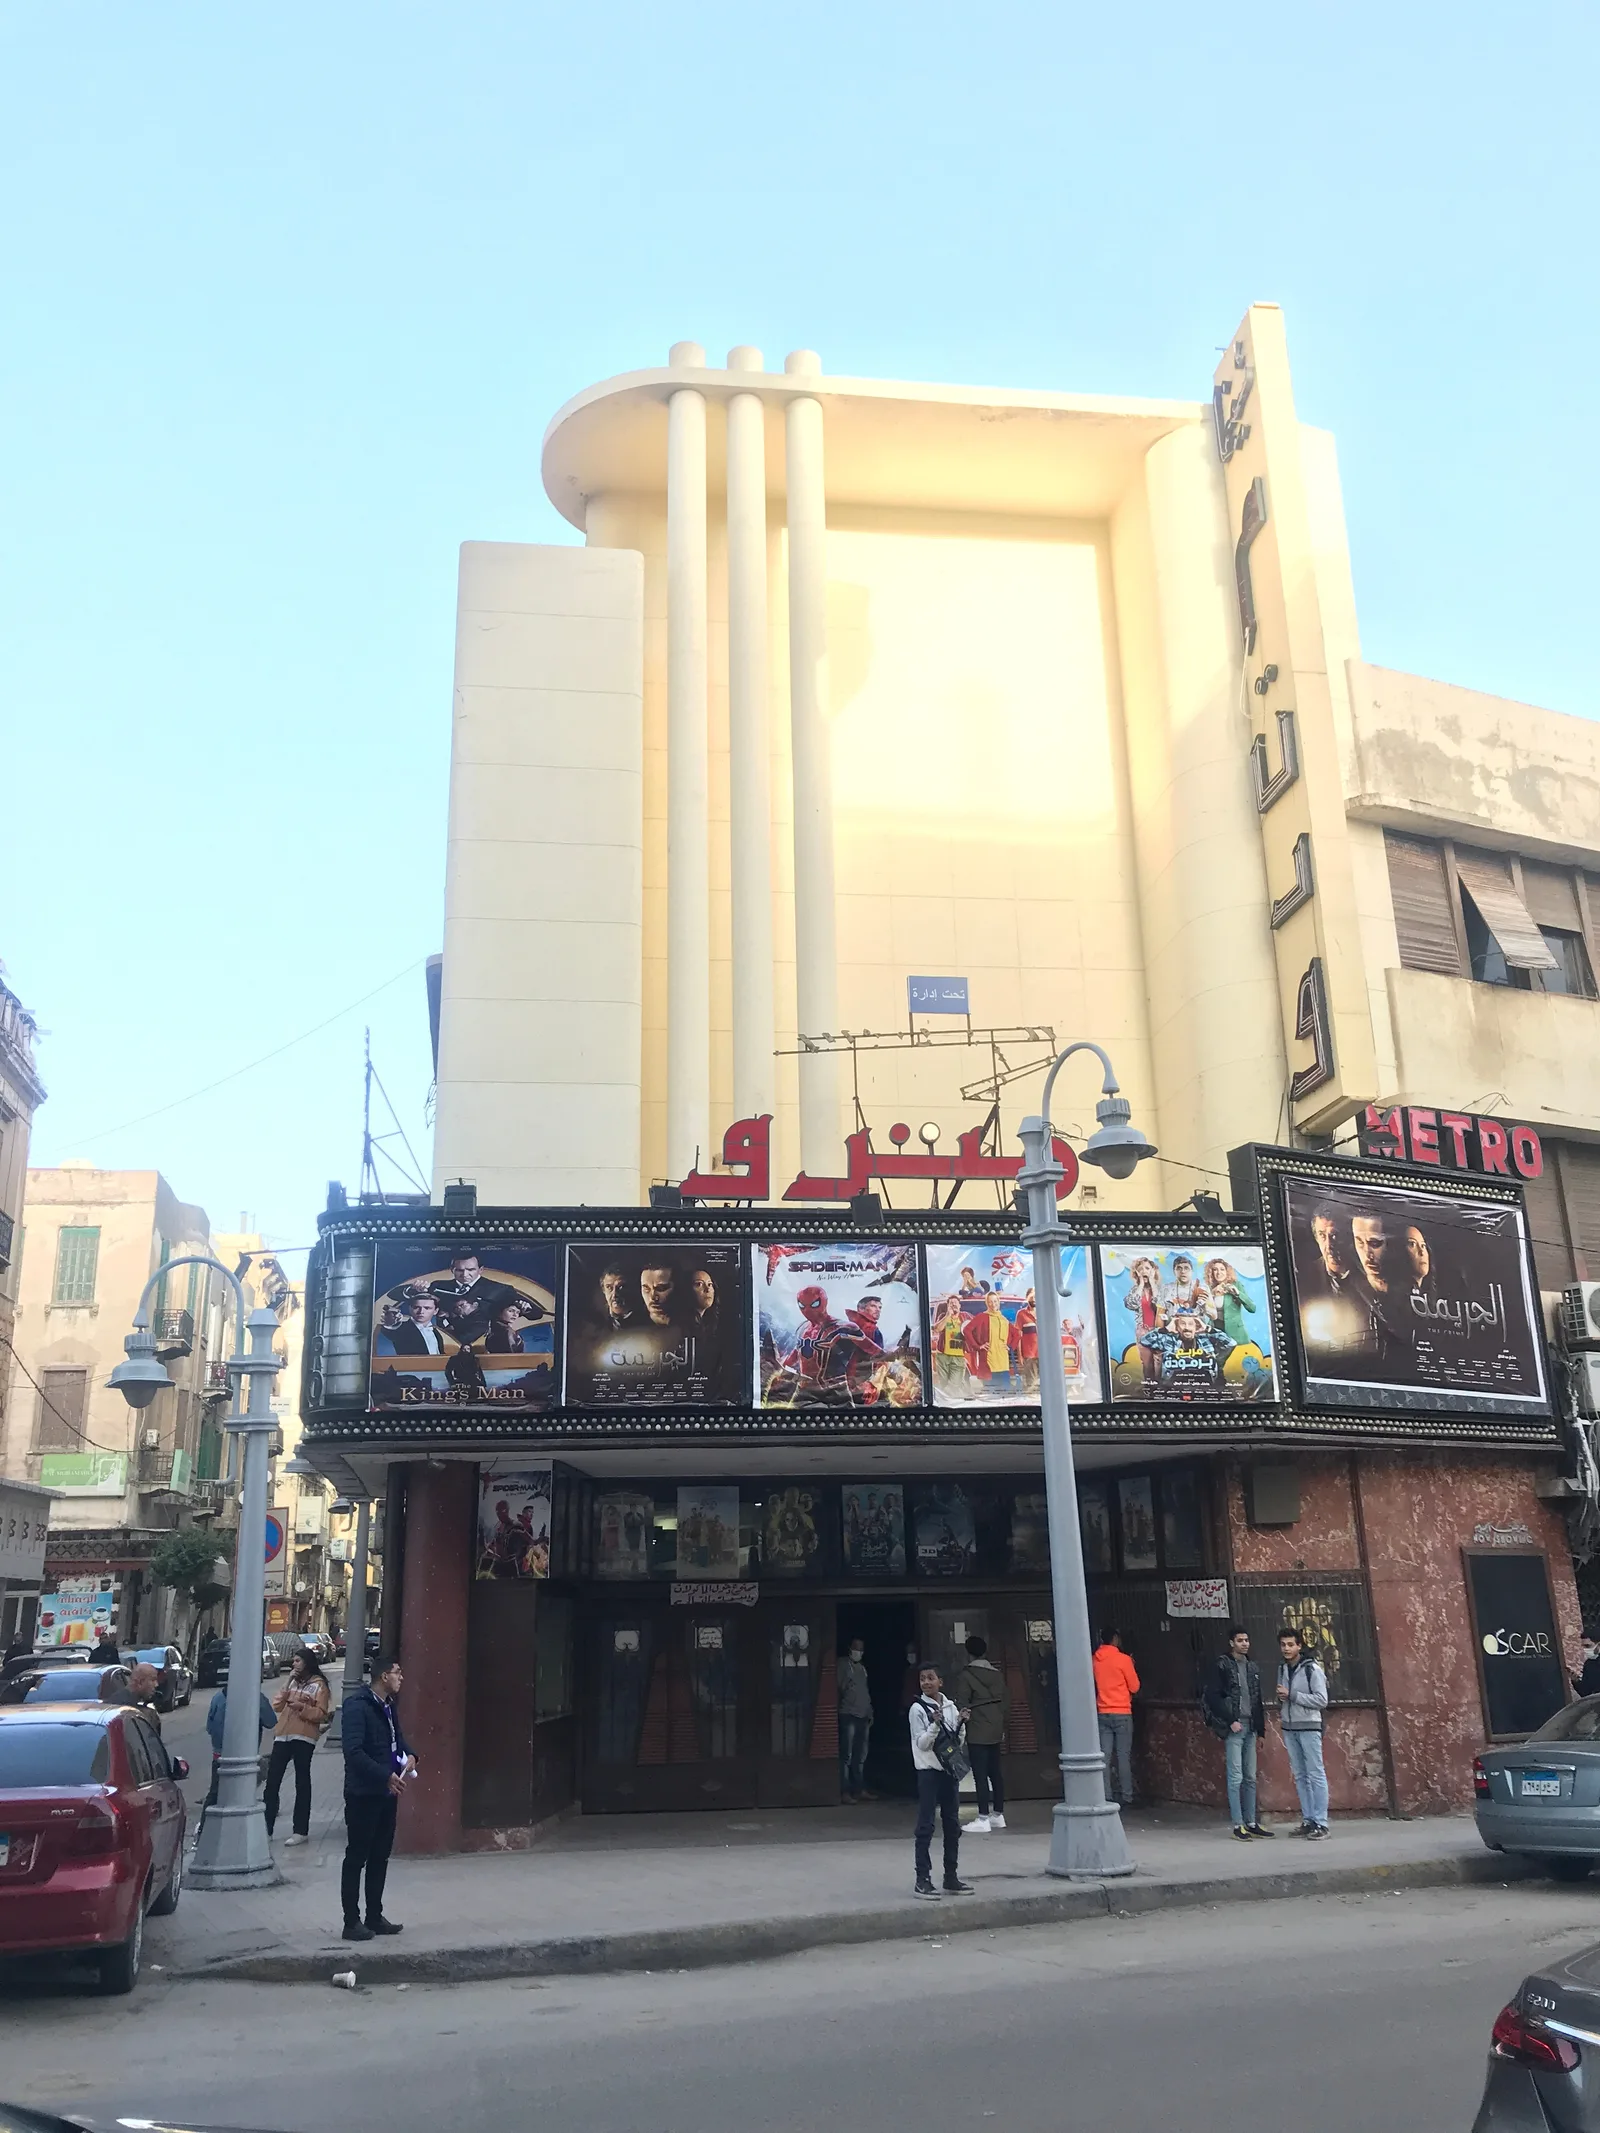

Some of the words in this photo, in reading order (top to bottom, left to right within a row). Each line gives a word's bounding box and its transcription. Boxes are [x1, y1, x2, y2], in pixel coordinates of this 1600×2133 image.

[912, 987, 938, 1002] إدارة
[942, 989, 966, 999] تحت
[1364, 1103, 1544, 1180] METRO
[1409, 1282, 1507, 1343] الجريمة
[611, 1336, 697, 1378] الجريمة
[1164, 1356, 1214, 1370] برمودة
[1175, 1347, 1205, 1360] مربع
[400, 1387, 470, 1404] King's
[476, 1385, 526, 1400] Man
[1482, 1627, 1553, 1656] OSCAR
